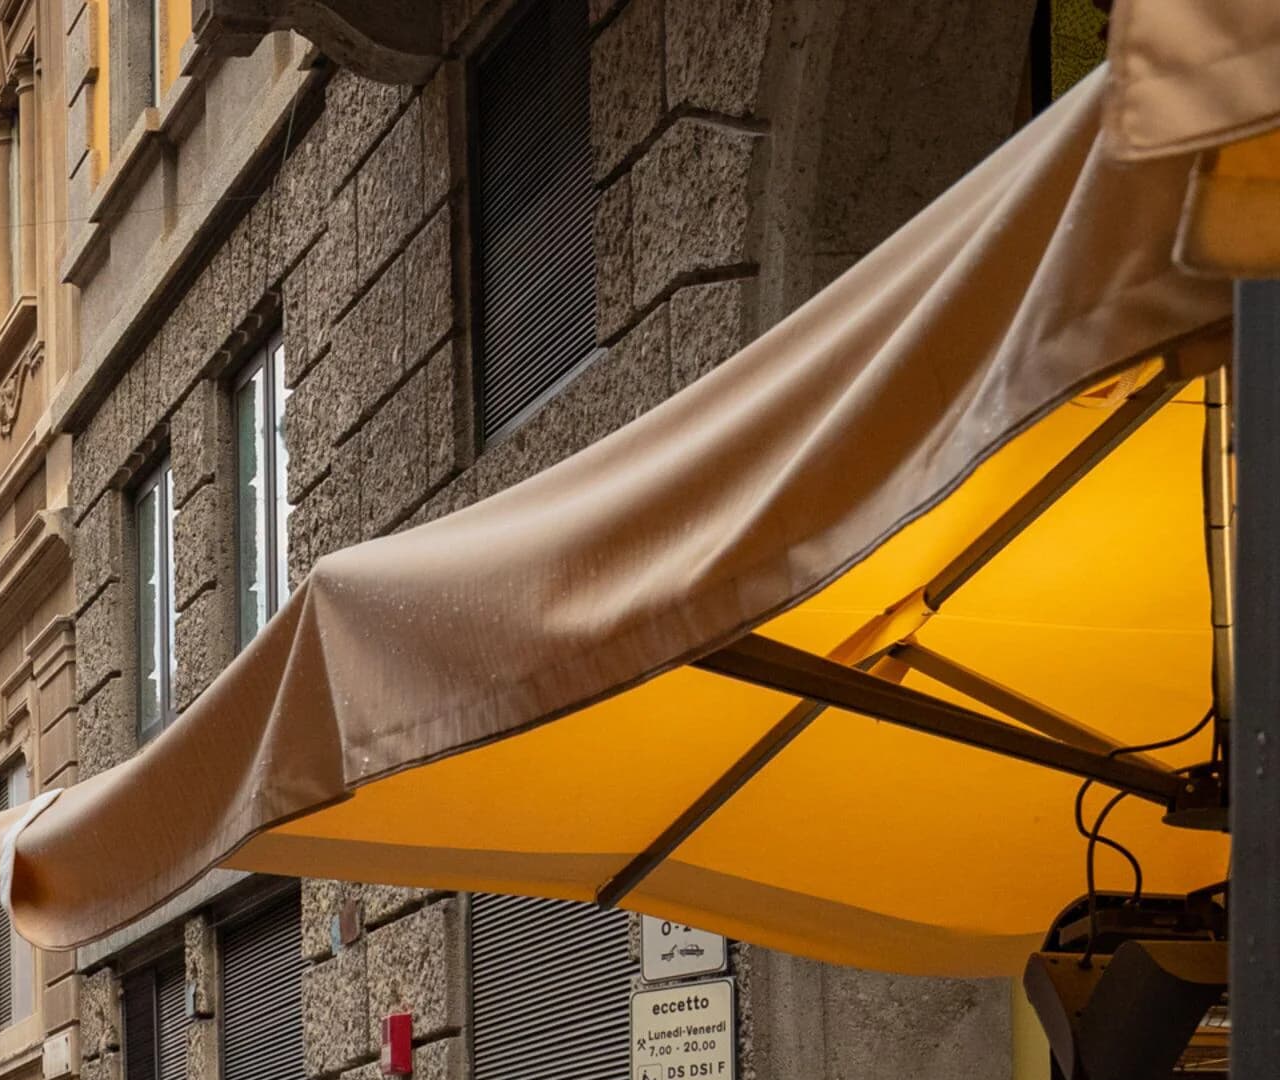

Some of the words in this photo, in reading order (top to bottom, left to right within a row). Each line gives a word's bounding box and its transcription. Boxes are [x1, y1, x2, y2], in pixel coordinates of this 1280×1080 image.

[652, 996, 709, 1015] eccetto
[668, 1066, 685, 1079] DS
[690, 1063, 713, 1077] DSI
[718, 1061, 725, 1074] F
